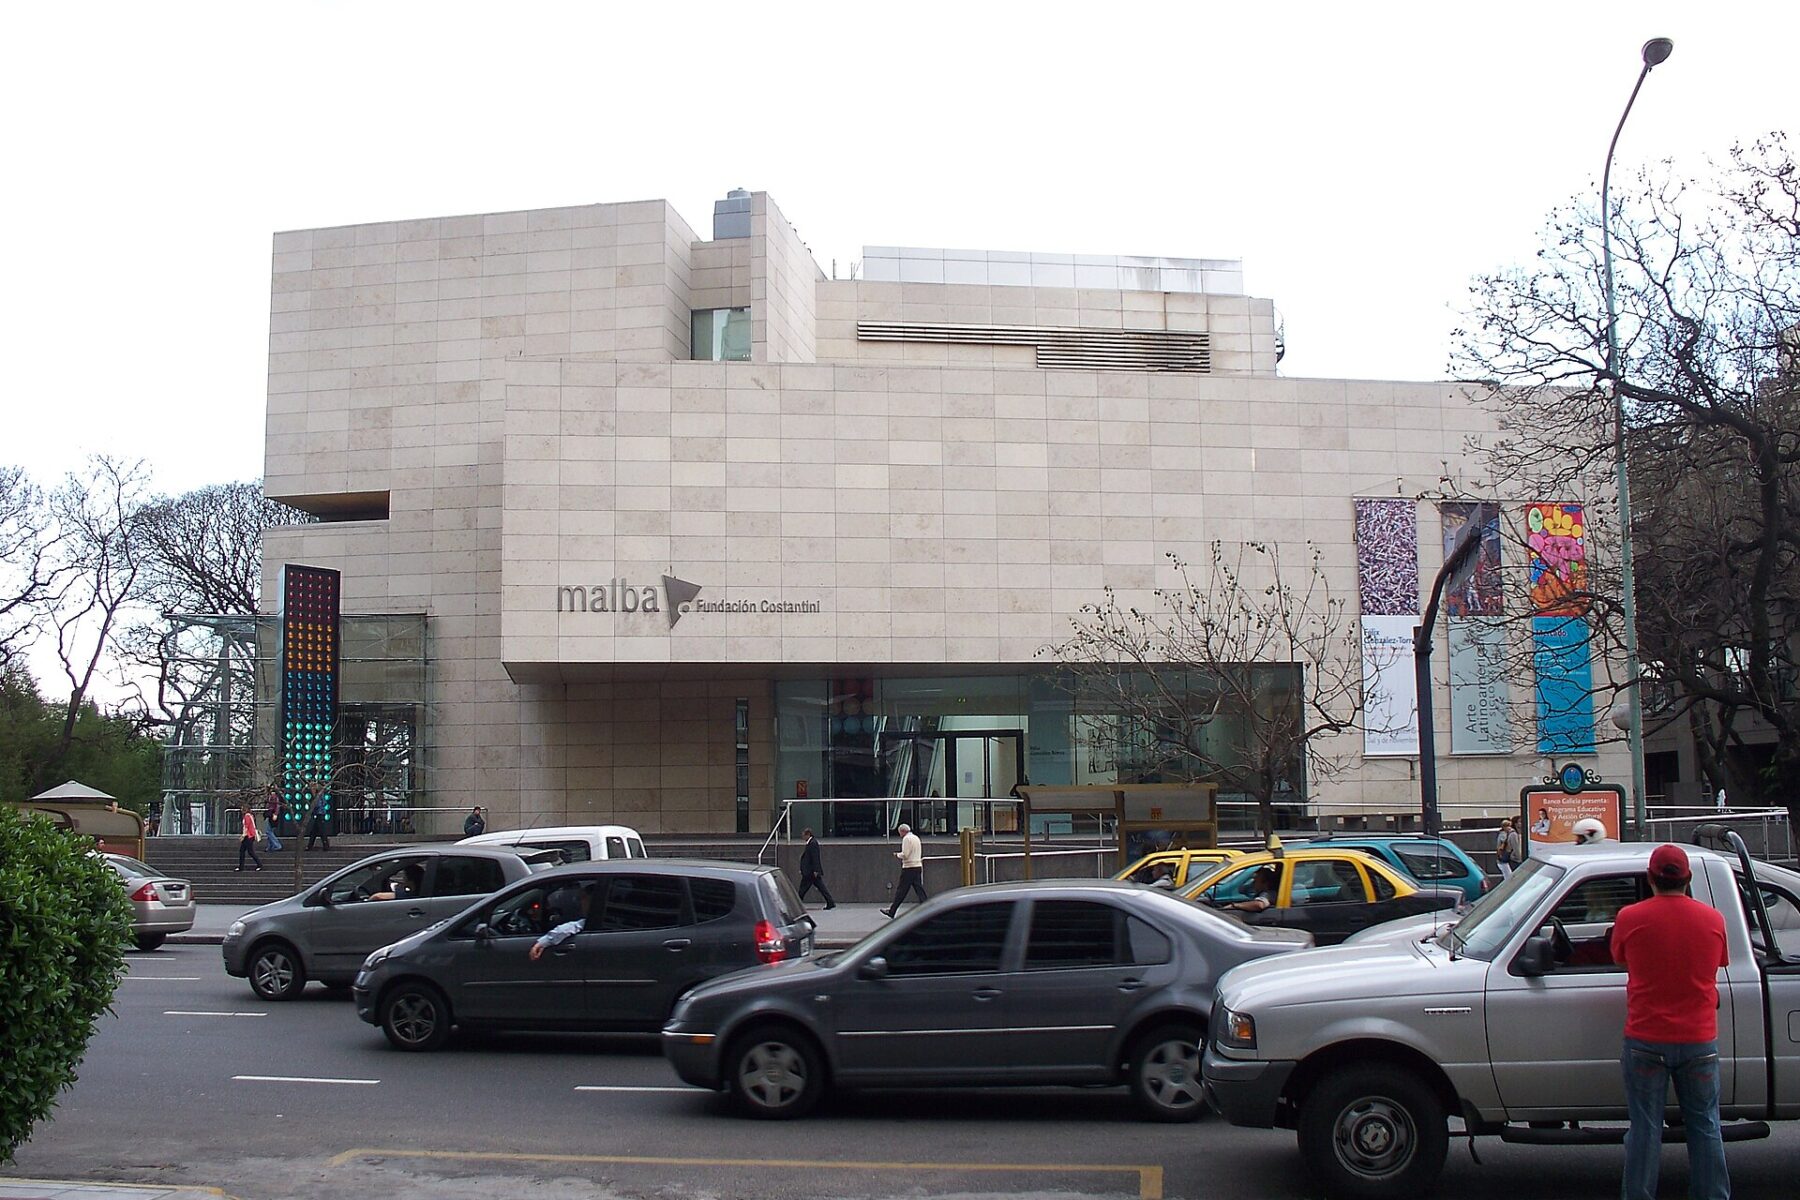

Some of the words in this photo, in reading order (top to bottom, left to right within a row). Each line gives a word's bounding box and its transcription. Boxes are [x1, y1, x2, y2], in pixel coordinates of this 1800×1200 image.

[558, 578, 660, 613] malba
[696, 599, 757, 613] Fundación
[760, 599, 820, 613] Costantini
[1465, 704, 1477, 733] Arte
[1548, 806, 1577, 814] Programa
